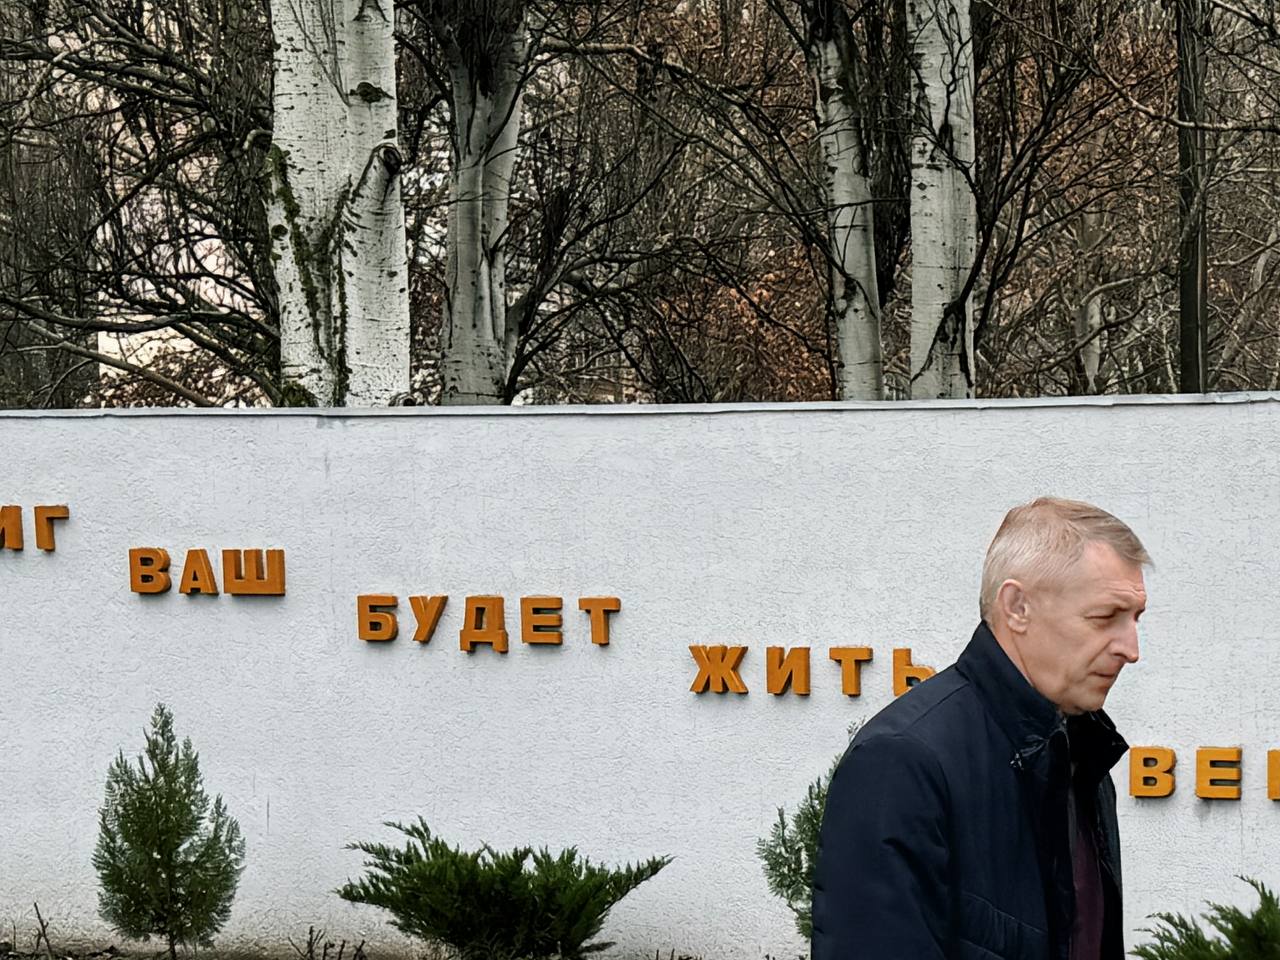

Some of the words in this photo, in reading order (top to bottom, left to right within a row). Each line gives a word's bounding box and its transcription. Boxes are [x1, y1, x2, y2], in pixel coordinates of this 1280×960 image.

[128, 547, 286, 596] ВАШ
[357, 594, 622, 654] БУДЕТ
[688, 644, 937, 697] ЖИТЬ
